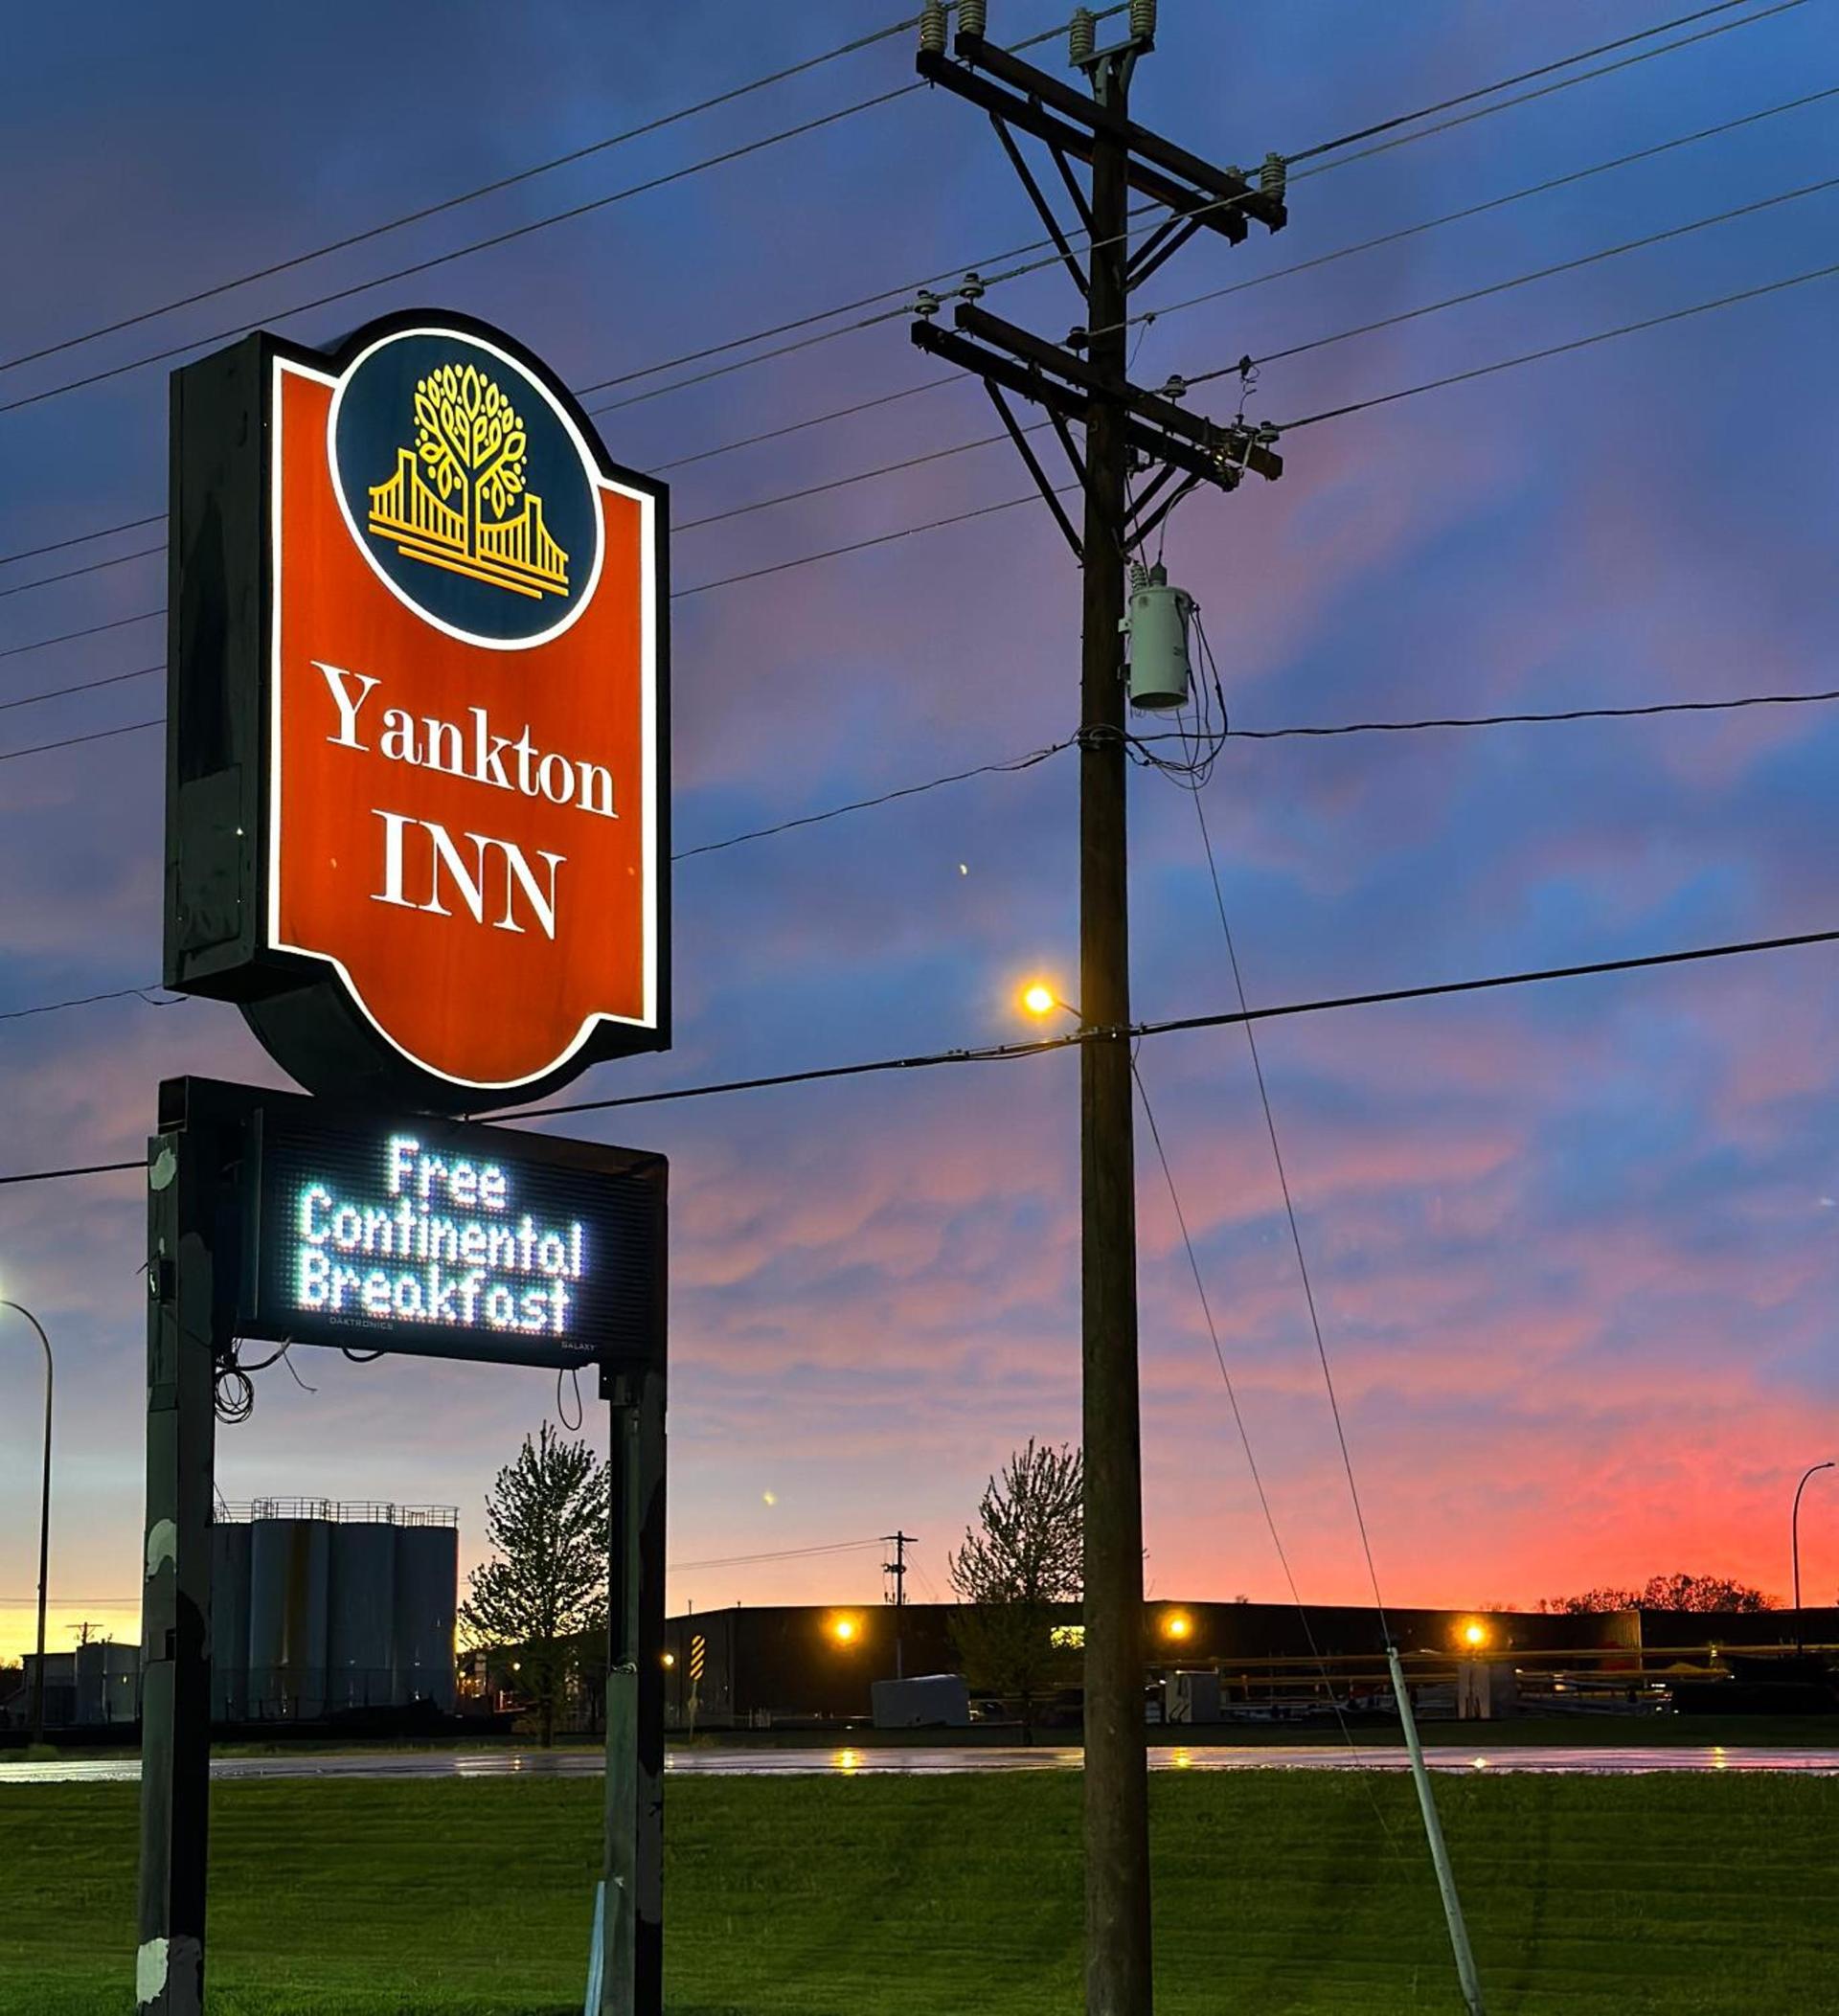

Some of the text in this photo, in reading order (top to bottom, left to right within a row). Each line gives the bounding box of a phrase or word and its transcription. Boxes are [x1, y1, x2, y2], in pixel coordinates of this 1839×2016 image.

[310, 660, 619, 819] Yankton
[370, 808, 567, 940] INN
[389, 1133, 506, 1209] Free
[299, 1183, 584, 1278] Continental
[298, 1247, 571, 1333] Breakfast
[329, 1316, 394, 1330] DAKTRONICS
